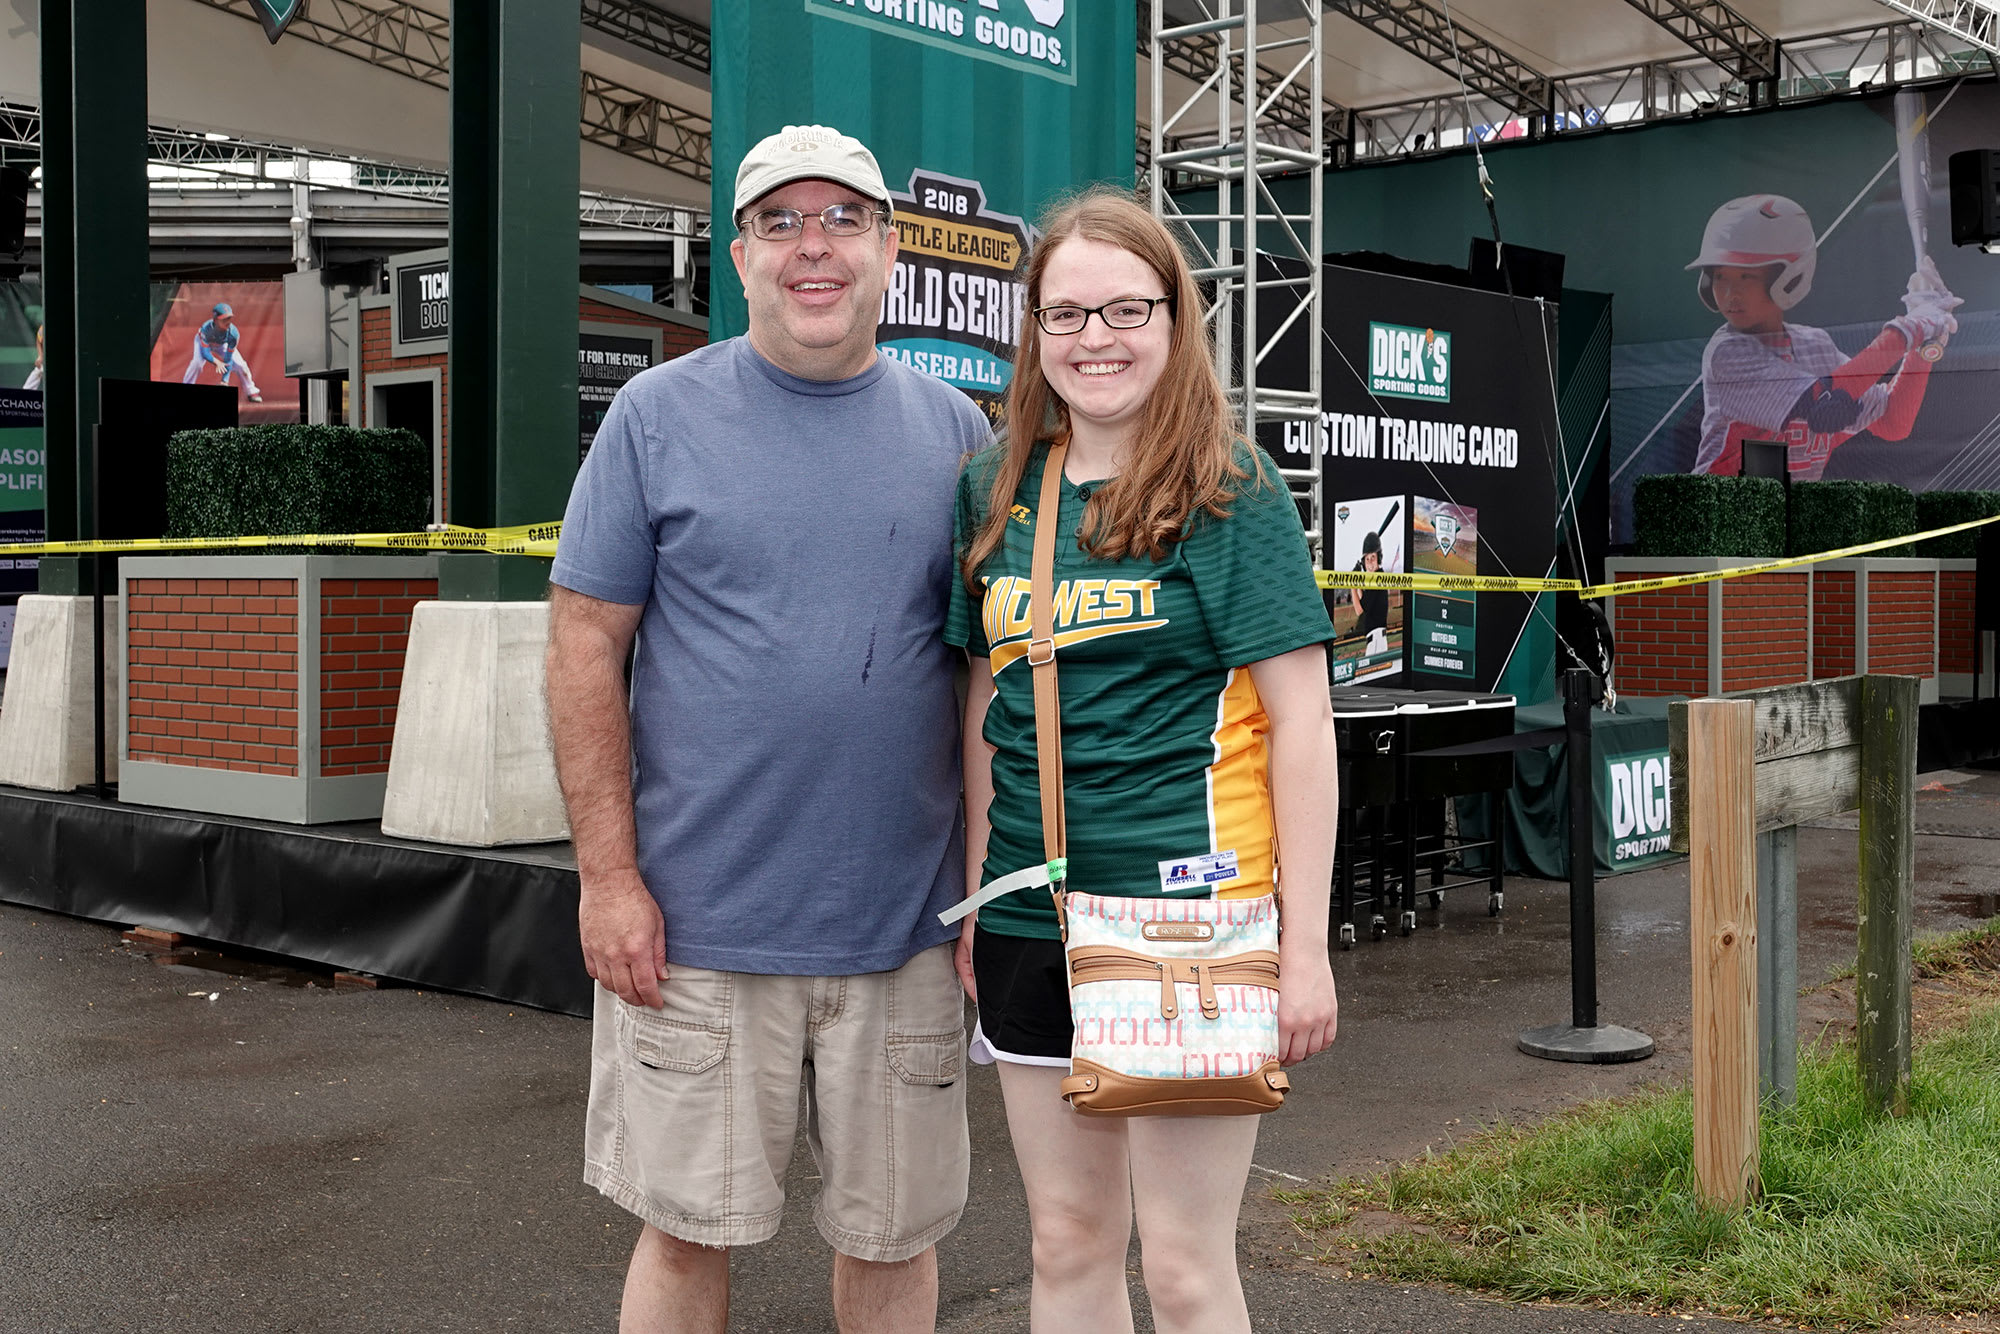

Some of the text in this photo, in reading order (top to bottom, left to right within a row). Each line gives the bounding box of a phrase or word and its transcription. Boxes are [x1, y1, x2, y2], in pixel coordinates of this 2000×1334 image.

[975, 15, 1062, 66] GOODS
[924, 188, 967, 216] 2018
[892, 219, 1010, 263] TTLE LEAGUE
[878, 262, 1029, 348] RLD SERIE
[587, 351, 604, 364] FOR
[605, 352, 621, 365] THE
[622, 353, 648, 367] CYCLE
[1373, 327, 1447, 384] DICK'S
[881, 346, 1001, 386] BASEBALL
[1373, 378, 1447, 397] SPORTING GOODS
[1380, 417, 1465, 464] TRADING
[1469, 425, 1518, 469] CARD
[386, 533, 431, 547] CAUTION
[442, 532, 487, 547] CUIDADO
[1327, 573, 1366, 587] CAUTION
[1375, 575, 1413, 588] CUIDADO
[1438, 577, 1475, 589] CAUTION
[1441, 608, 1448, 619] 12
[1431, 631, 1457, 645] OUTFIELDER
[1424, 655, 1464, 671] SUMMER FOREVER
[1166, 874, 1196, 883] RUSSELL
